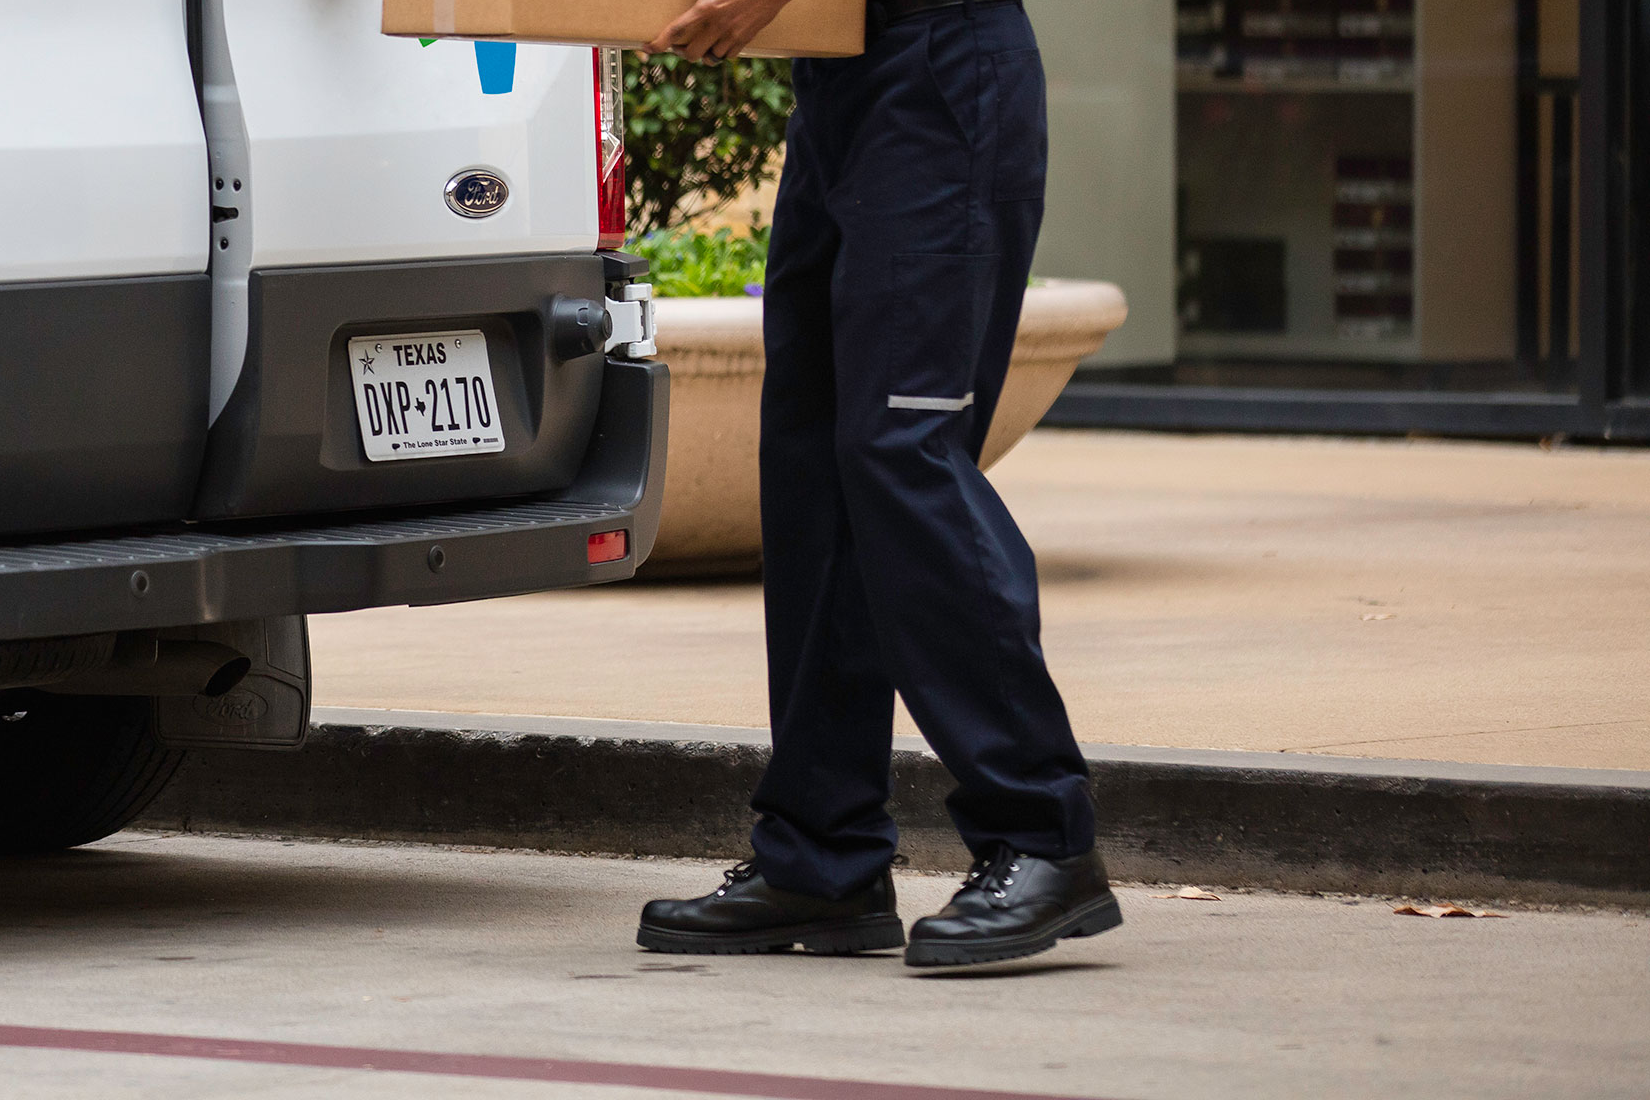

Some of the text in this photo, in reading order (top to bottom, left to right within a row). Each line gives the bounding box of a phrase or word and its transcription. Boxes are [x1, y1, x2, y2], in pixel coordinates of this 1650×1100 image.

[464, 180, 499, 206] Ford
[393, 342, 447, 367] TEXAS
[363, 376, 492, 436] DXP 2170
[417, 440, 433, 448] Lone
[434, 439, 448, 447] Star
[449, 438, 468, 446] State
